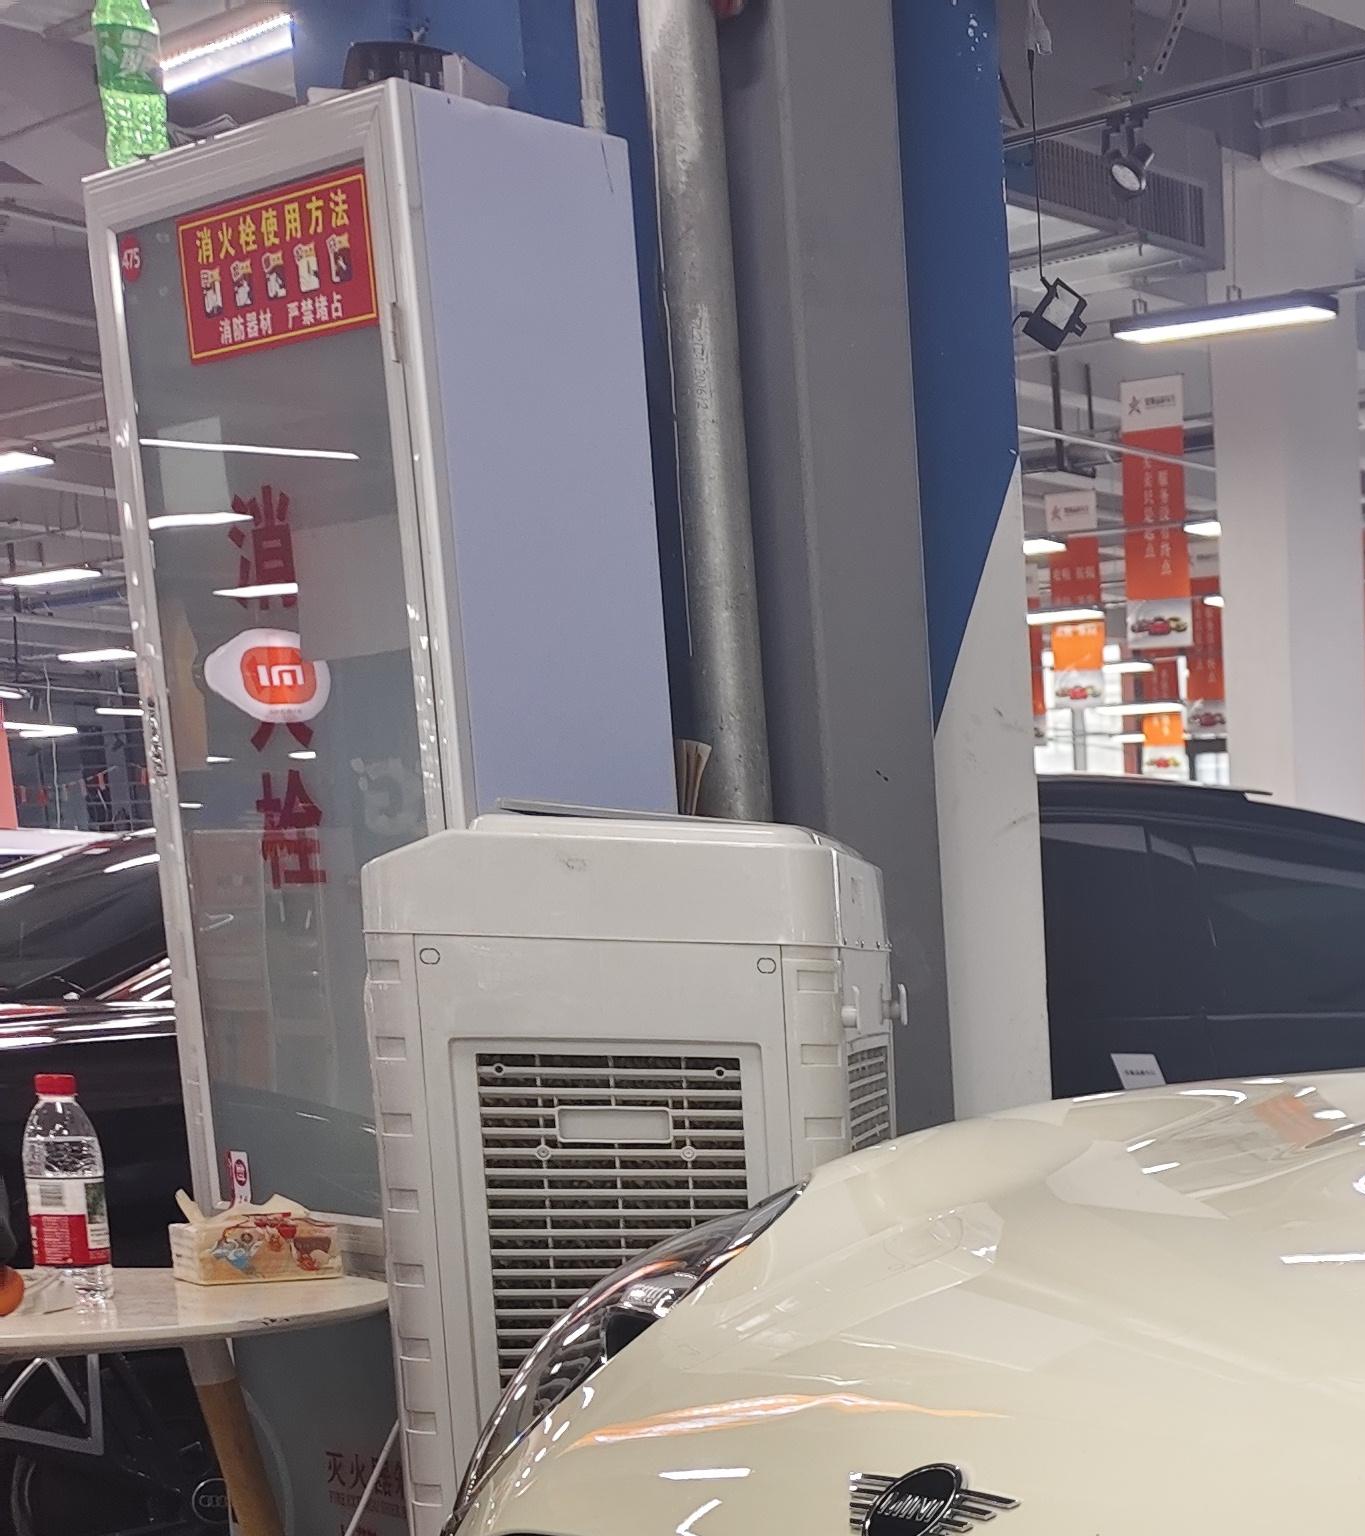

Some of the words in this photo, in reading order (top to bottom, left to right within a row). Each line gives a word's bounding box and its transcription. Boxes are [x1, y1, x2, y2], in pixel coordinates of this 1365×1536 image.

[196, 188, 350, 265] 消火栓使用方法
[219, 307, 273, 345] 消防器材
[877, 1491, 946, 1523] MINI
